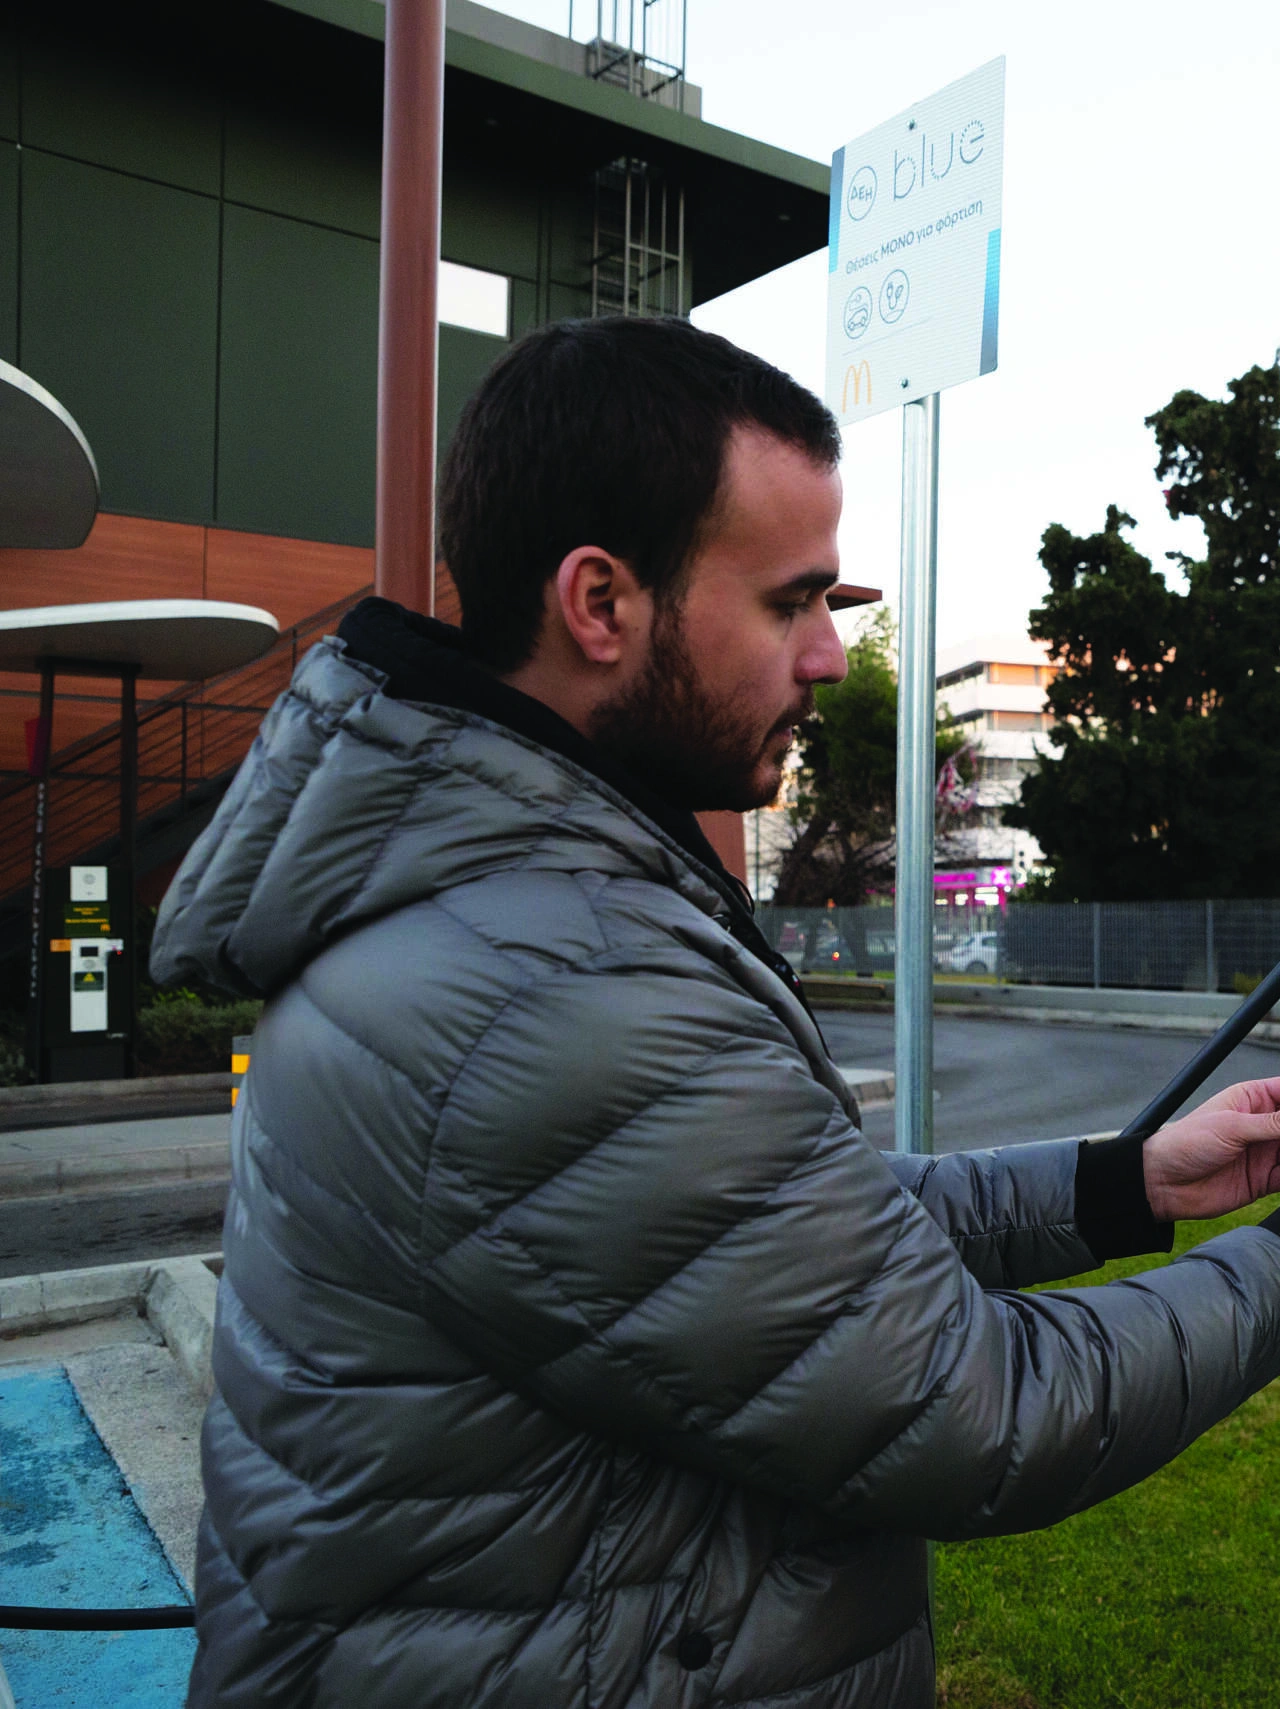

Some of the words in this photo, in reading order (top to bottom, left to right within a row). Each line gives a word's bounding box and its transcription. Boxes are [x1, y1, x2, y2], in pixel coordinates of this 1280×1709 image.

[851, 186, 873, 201] ΔΕΗ
[893, 119, 985, 202] blue
[845, 248, 880, 275] Θέσεις
[916, 223, 934, 246] για
[935, 198, 984, 236] φόρτιση
